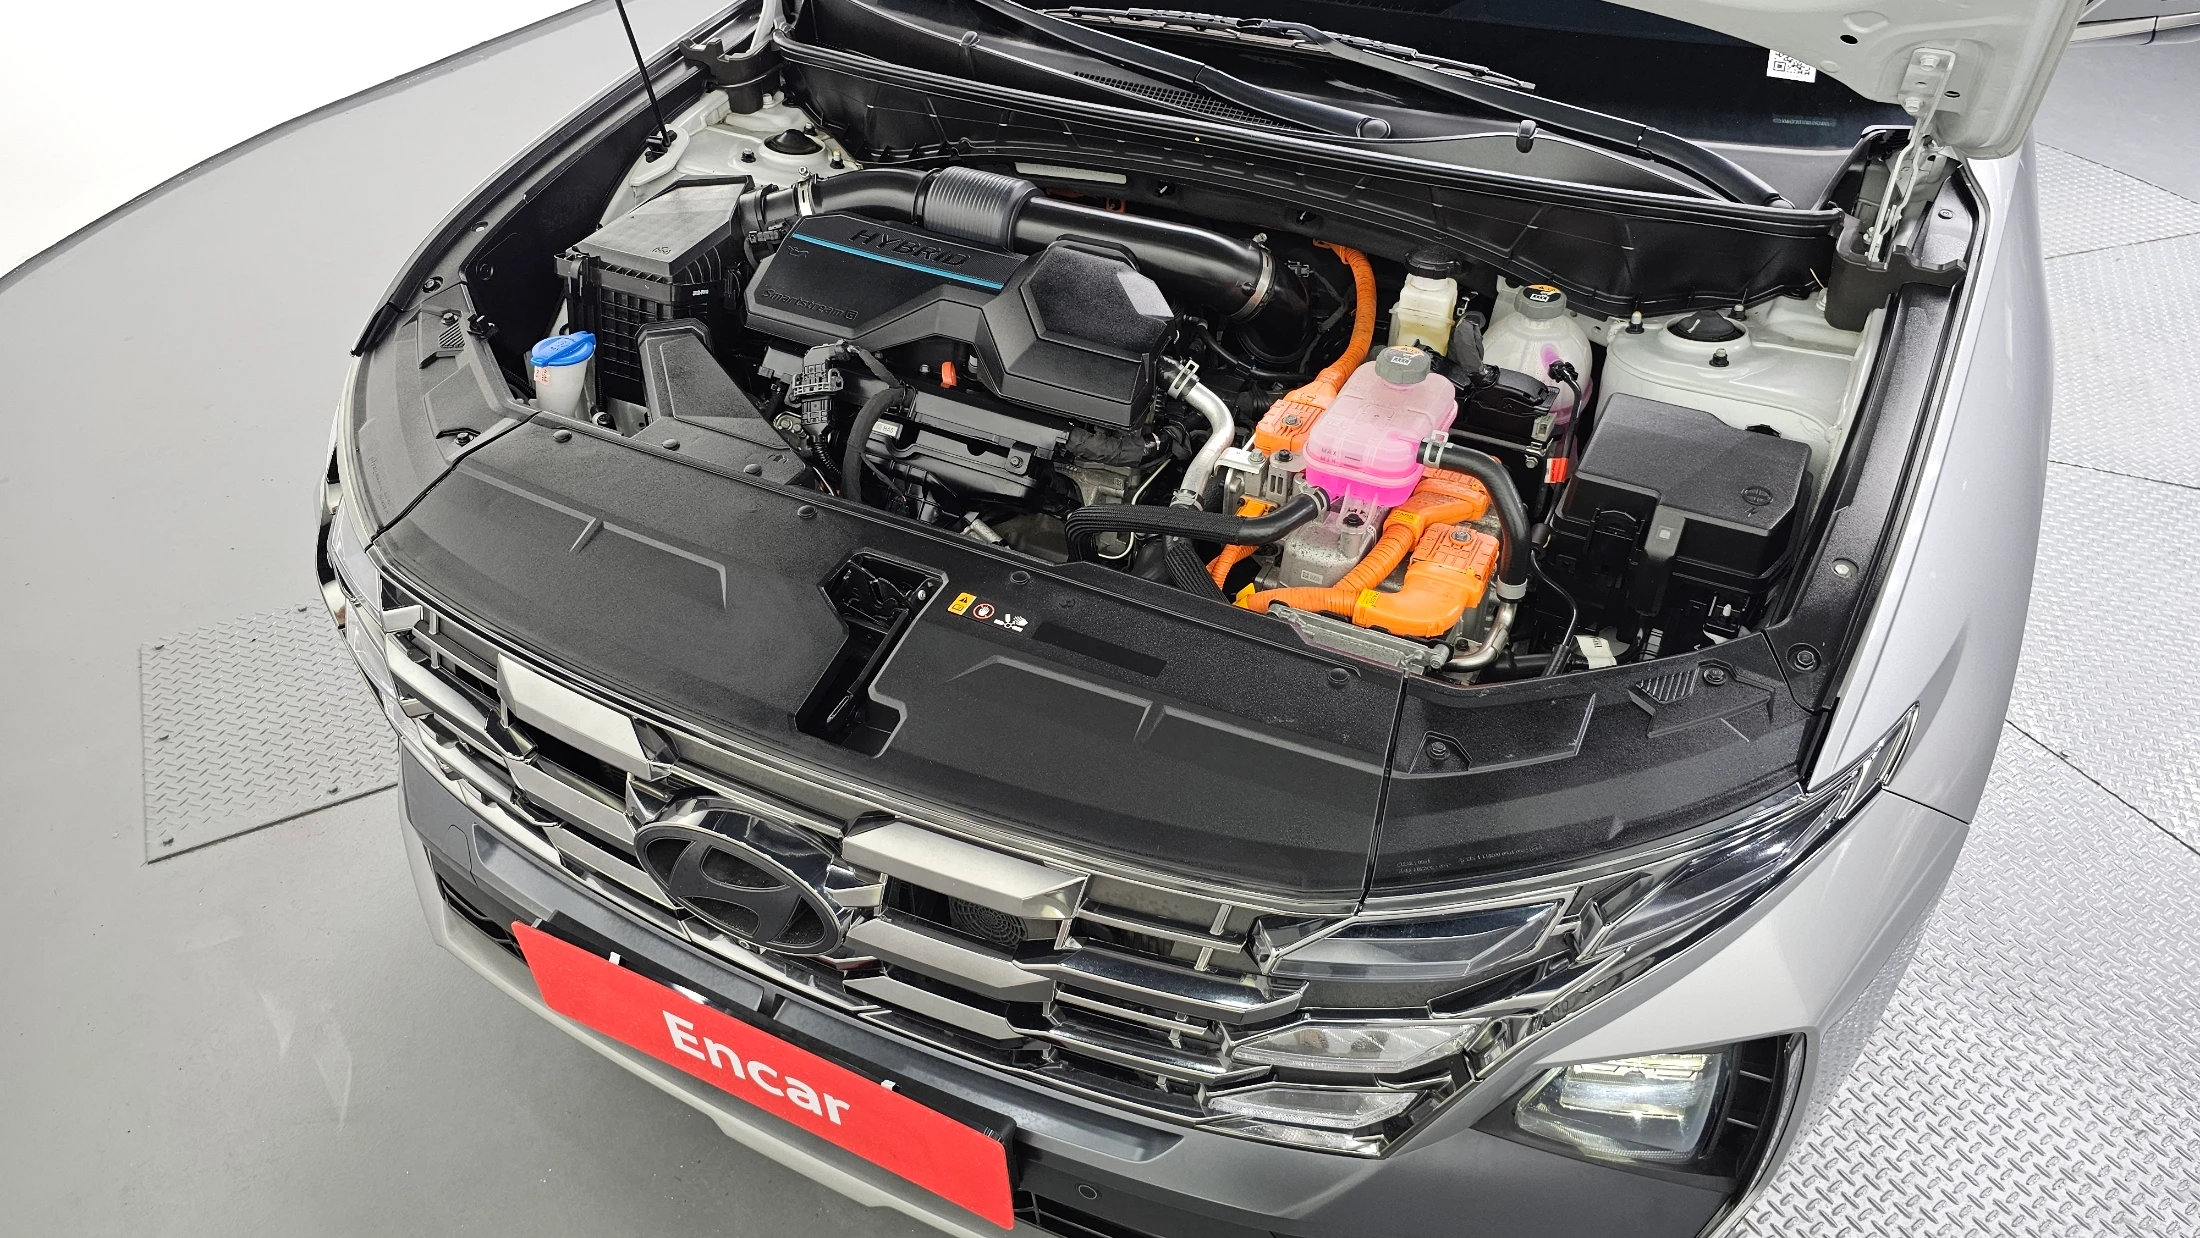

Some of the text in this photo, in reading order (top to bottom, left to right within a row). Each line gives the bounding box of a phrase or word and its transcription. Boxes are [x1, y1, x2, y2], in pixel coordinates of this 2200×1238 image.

[849, 229, 971, 266] HYBRID
[761, 288, 844, 318] Smartstream
[1320, 455, 1336, 464] MIN
[1321, 447, 1337, 456] MAX
[662, 1009, 850, 1126] Encar
